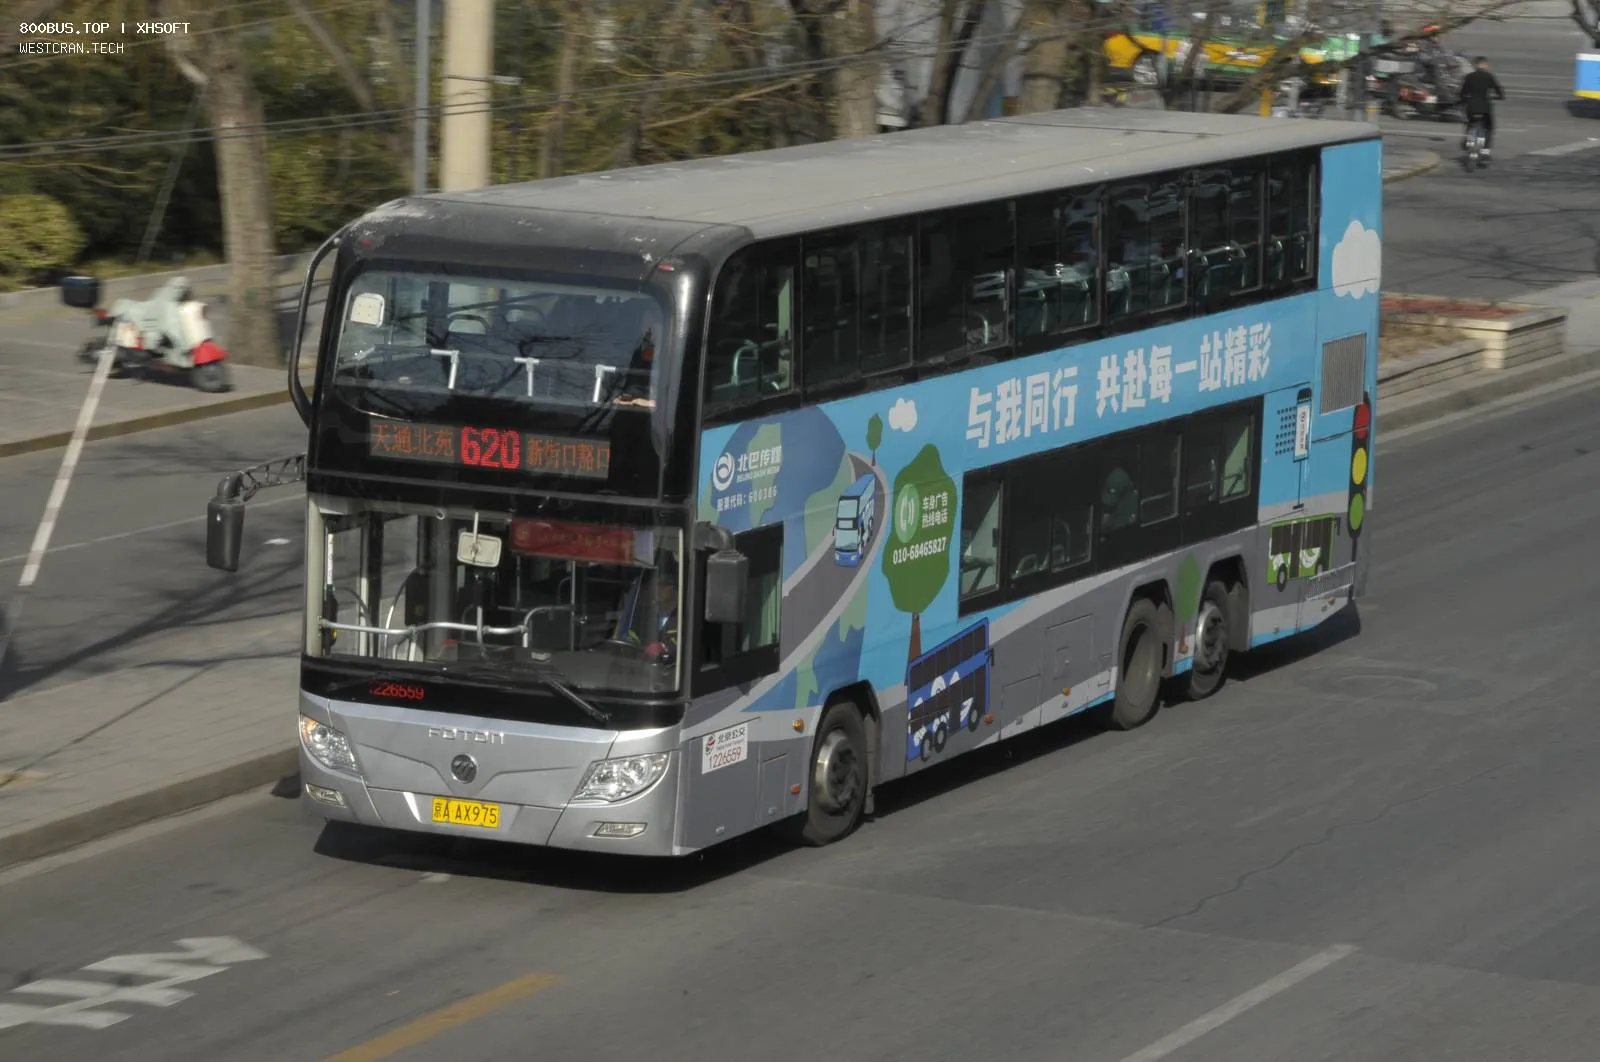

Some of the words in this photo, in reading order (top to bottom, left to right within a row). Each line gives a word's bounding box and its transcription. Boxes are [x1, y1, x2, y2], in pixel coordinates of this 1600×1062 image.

[966, 365, 1079, 449] 与我同行
[1096, 321, 1272, 418] 共赴每一站精彩
[371, 423, 454, 458] 天通北苑
[460, 425, 521, 469] 620
[737, 444, 782, 473] 北巴传媒
[892, 536, 947, 565] 010-68465827
[428, 726, 504, 745] FOTON
[709, 746, 742, 769] 1226559
